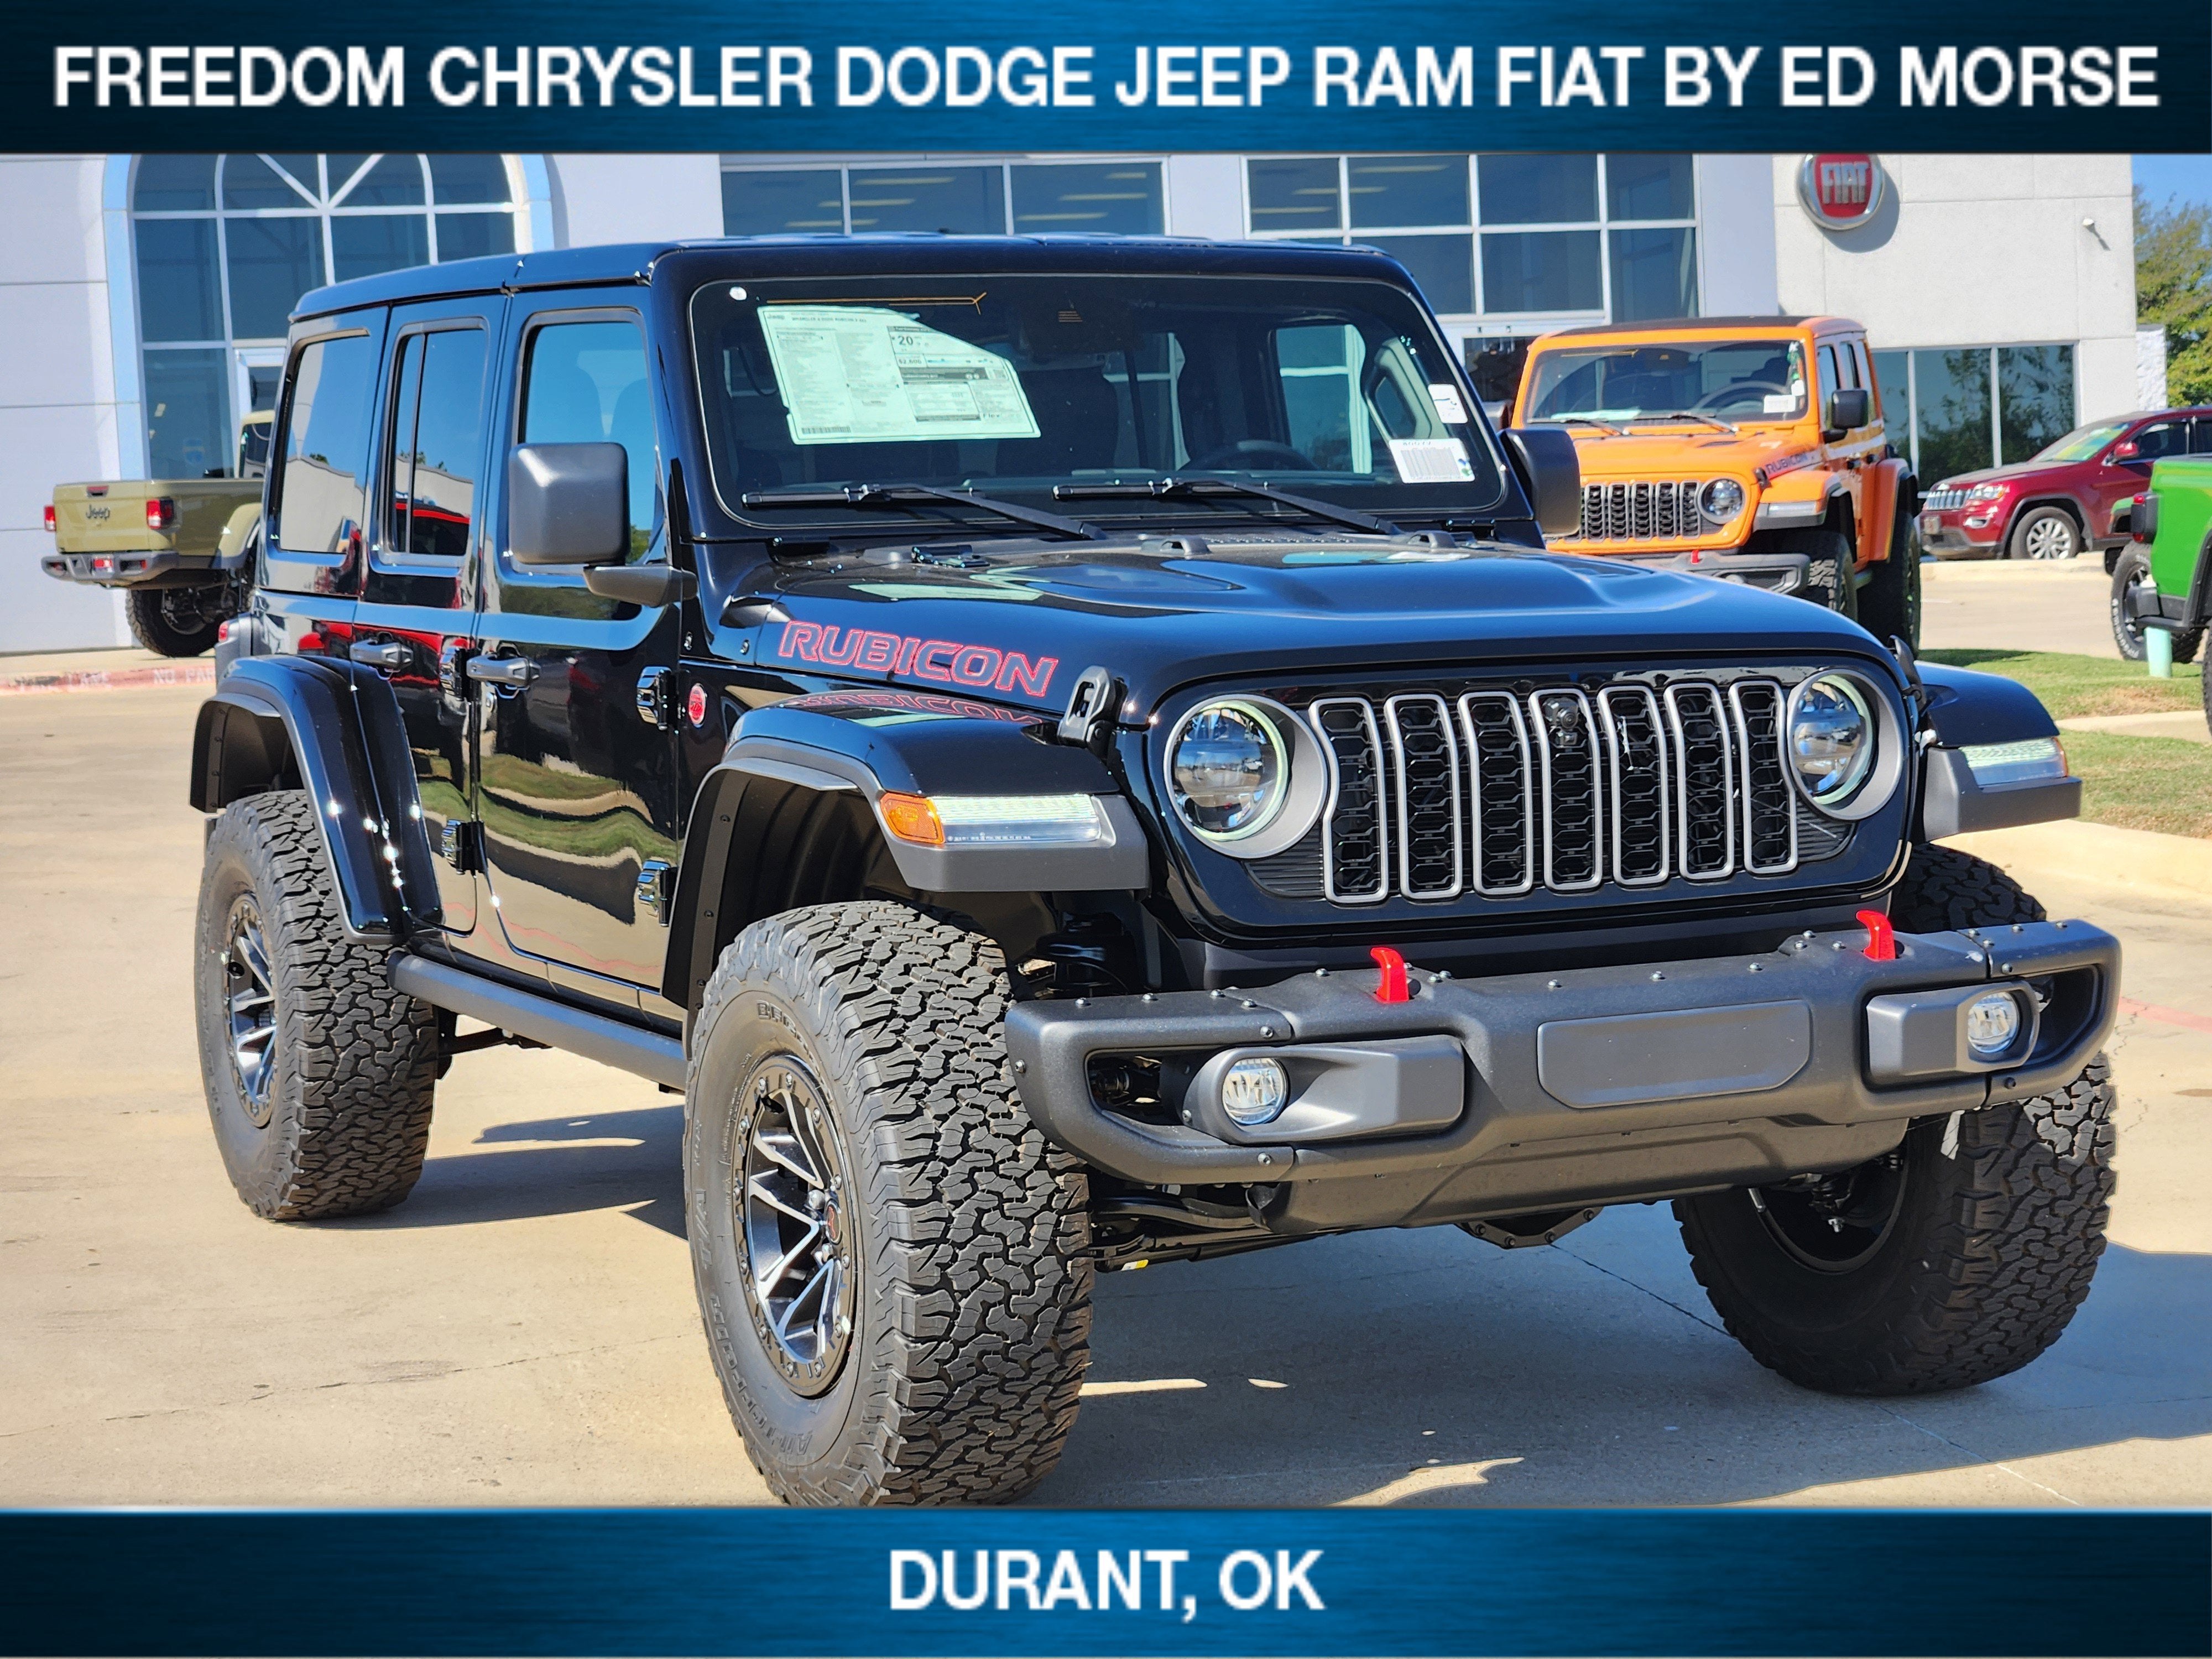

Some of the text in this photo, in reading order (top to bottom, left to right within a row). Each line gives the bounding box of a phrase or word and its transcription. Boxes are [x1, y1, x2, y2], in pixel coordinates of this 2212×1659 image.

[1820, 161, 1869, 205] FIAT
[897, 335, 914, 346] 20
[85, 503, 111, 522] Jeep
[778, 620, 1059, 698] RUBICON
